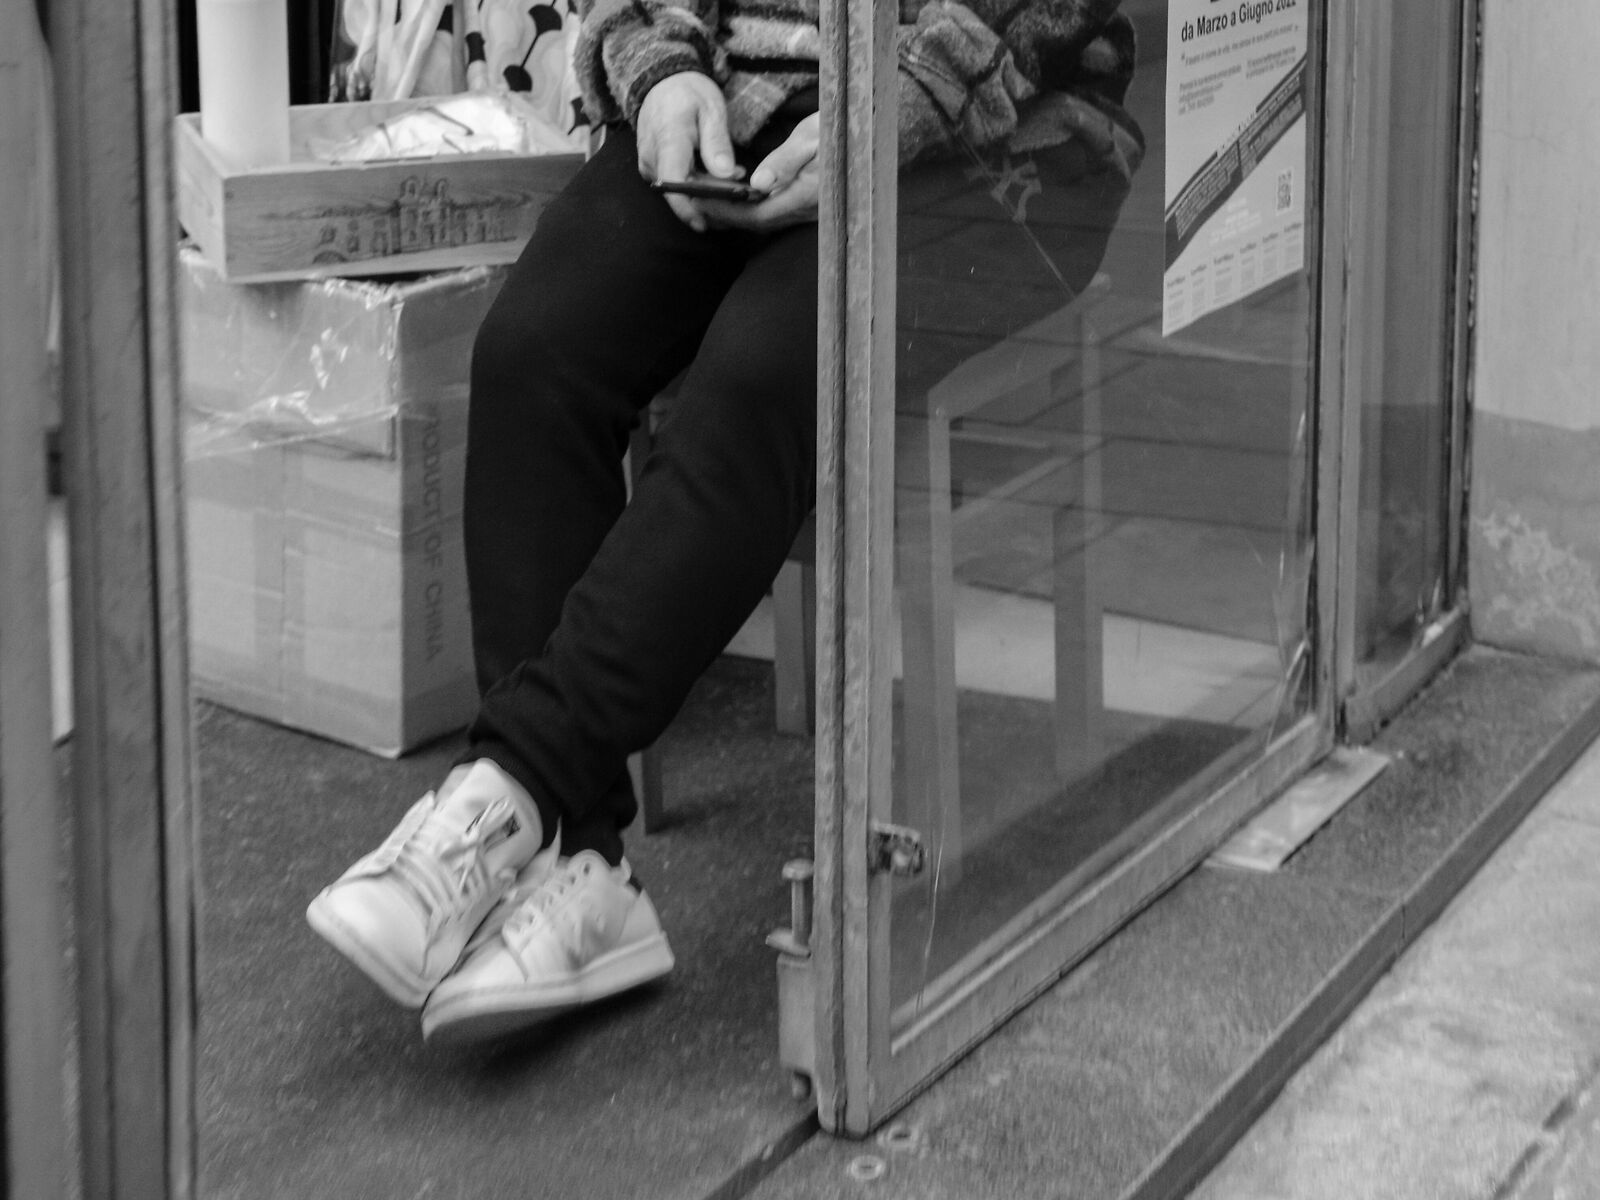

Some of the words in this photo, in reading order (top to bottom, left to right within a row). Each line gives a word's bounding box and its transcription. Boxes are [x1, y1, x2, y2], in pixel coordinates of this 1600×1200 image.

[1181, 21, 1194, 43] da
[1197, 9, 1228, 37] Marzo
[1230, 11, 1236, 27] a
[422, 405, 442, 521] RODUCT
